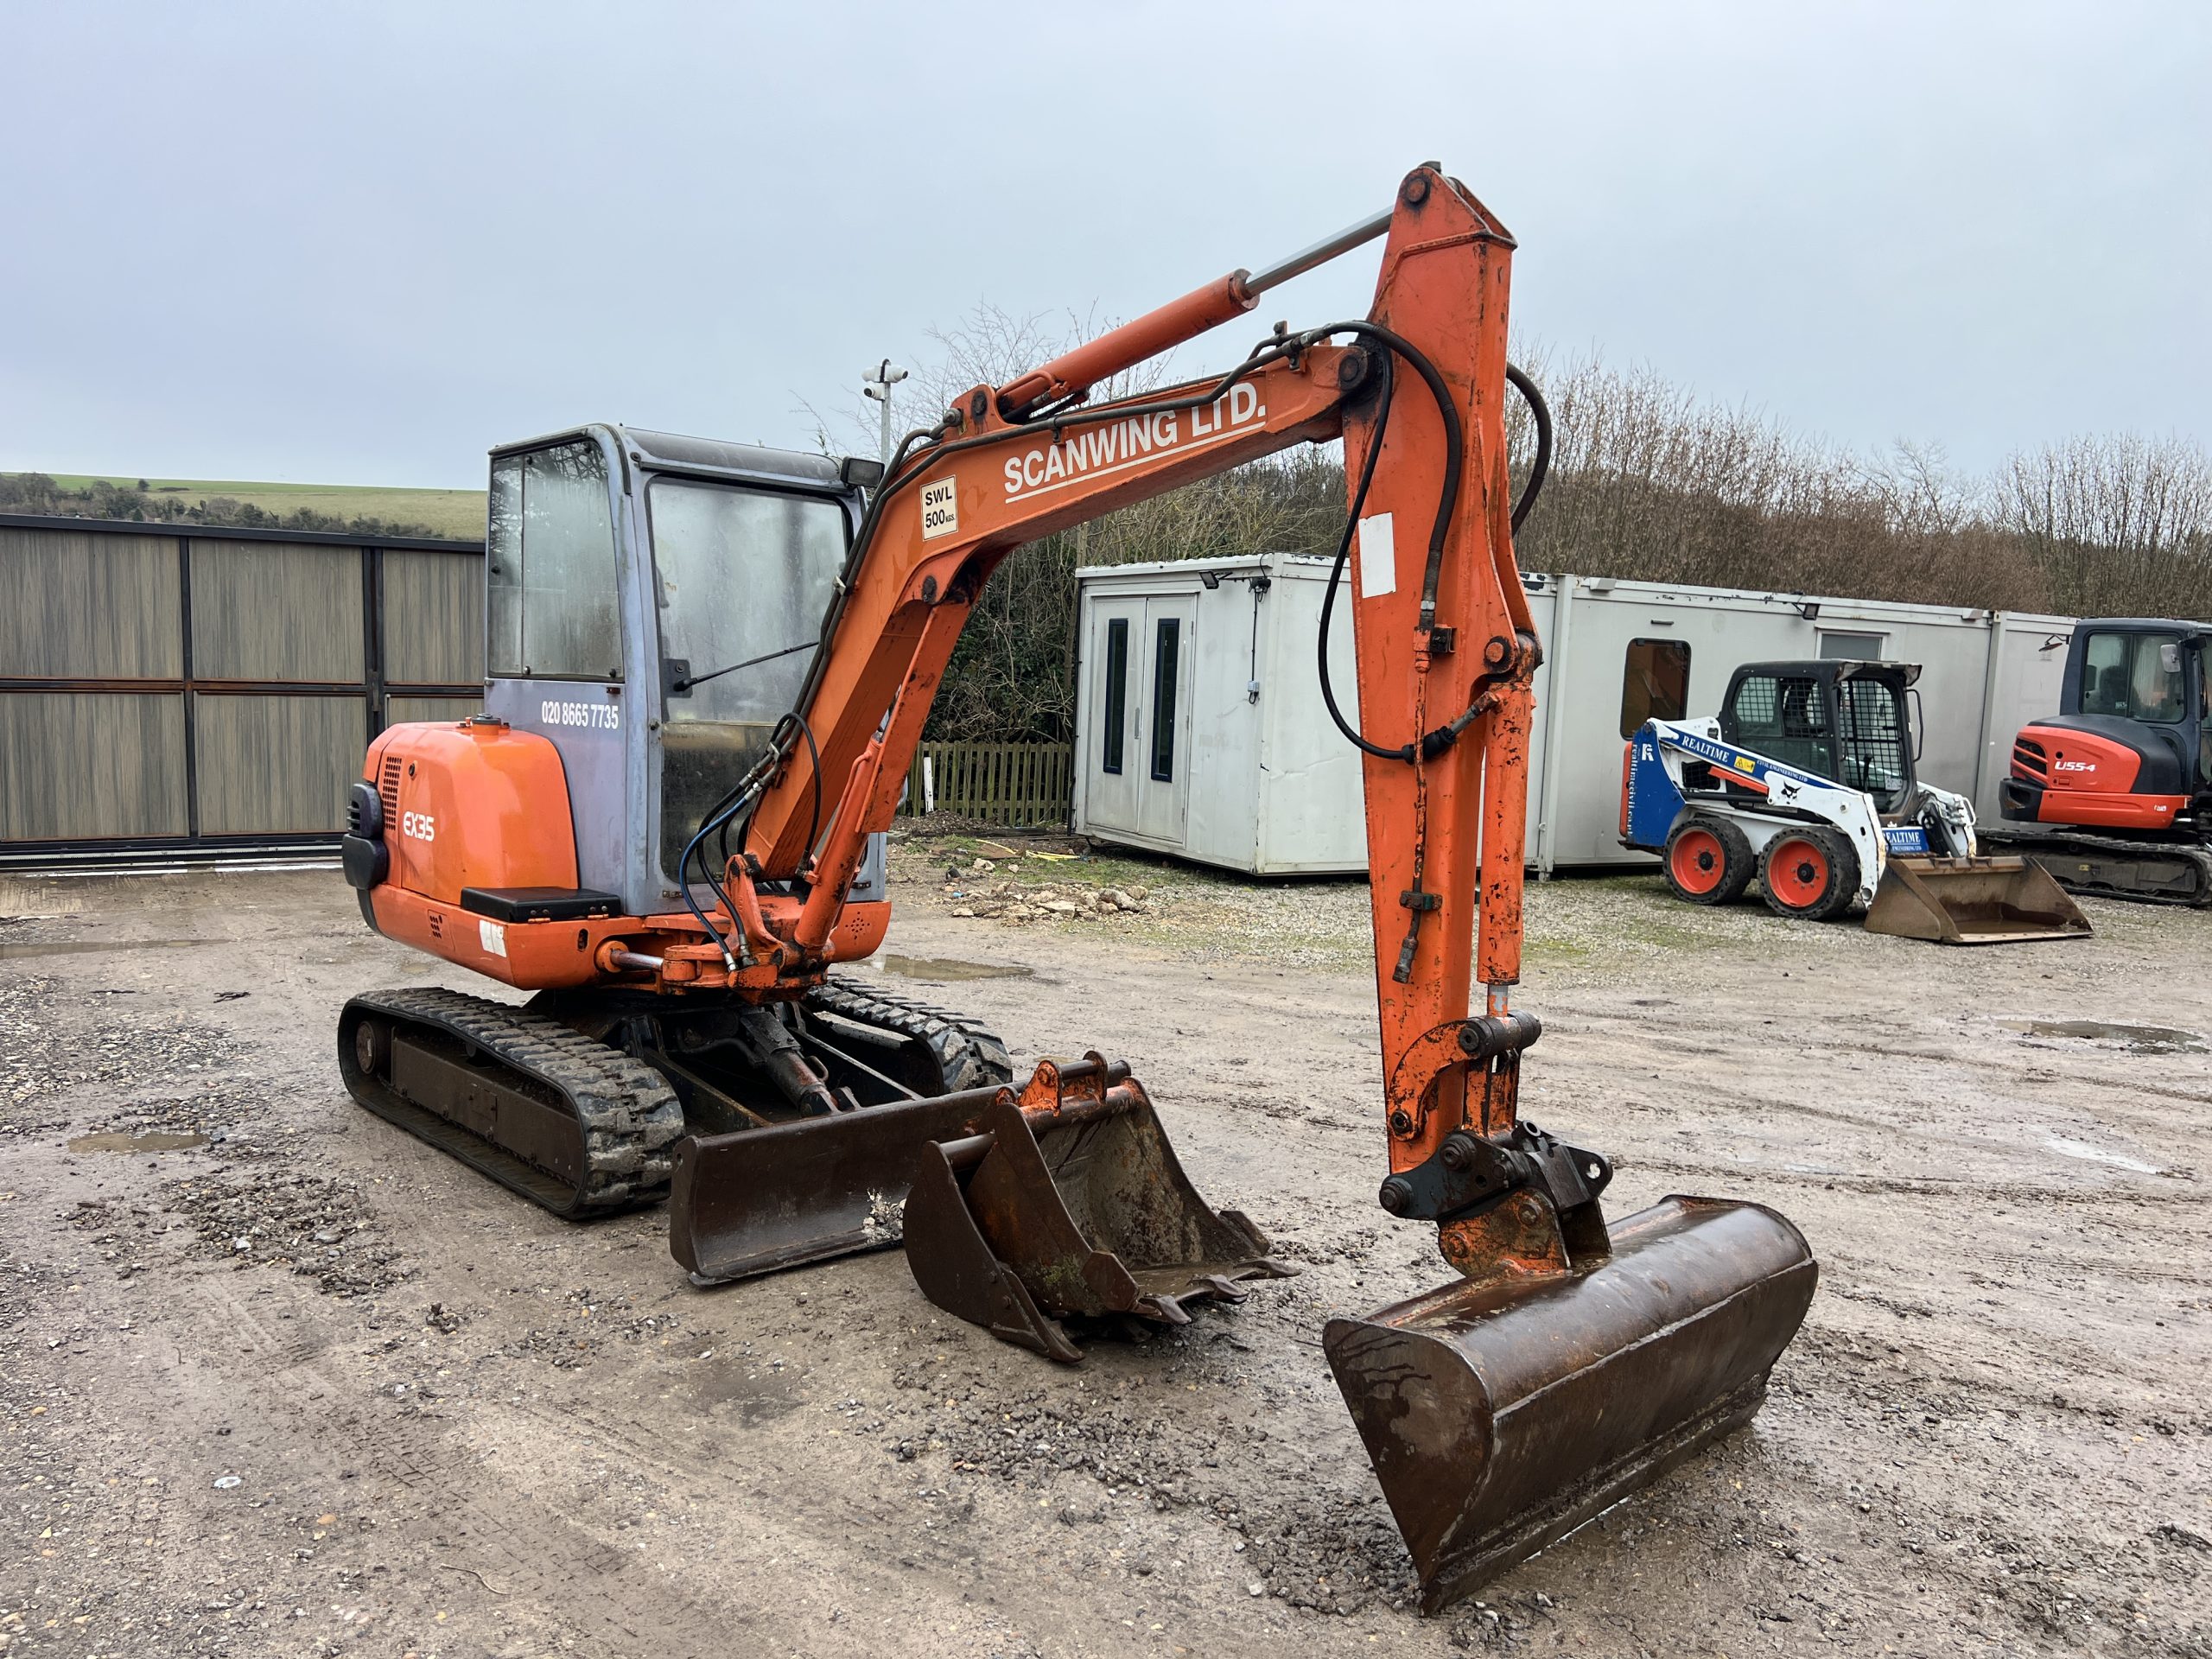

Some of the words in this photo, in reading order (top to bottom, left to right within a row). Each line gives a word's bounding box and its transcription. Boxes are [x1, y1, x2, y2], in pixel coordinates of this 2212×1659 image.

[1004, 410, 1178, 493] SCANWING
[1192, 382, 1266, 437] LTD.
[925, 486, 952, 506] SWL
[925, 509, 945, 529] 500
[542, 701, 561, 724] 020
[562, 702, 588, 727] 8665
[590, 704, 619, 729] 7735
[1681, 735, 1730, 763] REALTIME
[404, 810, 435, 842] EX35
